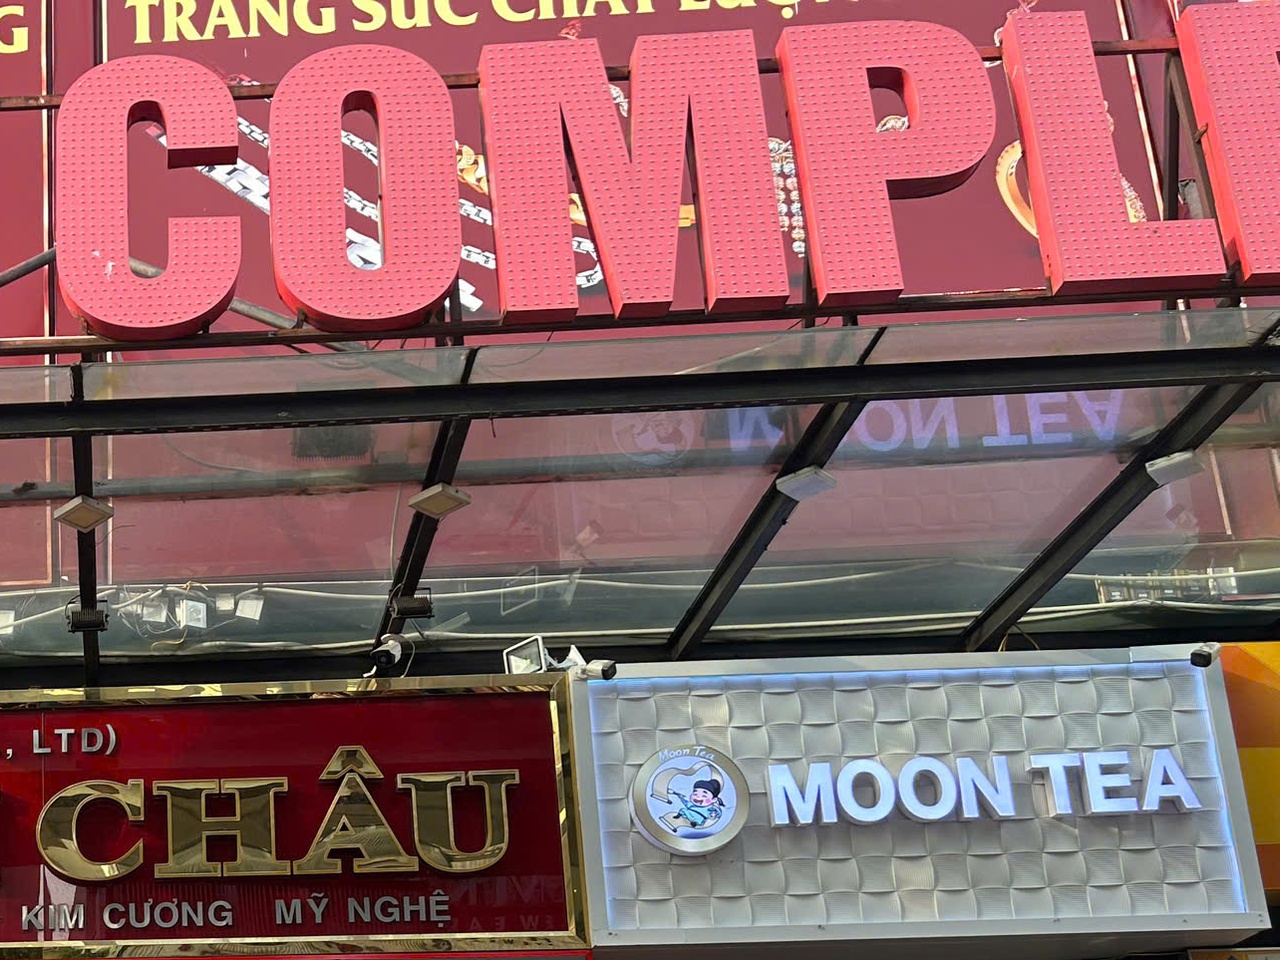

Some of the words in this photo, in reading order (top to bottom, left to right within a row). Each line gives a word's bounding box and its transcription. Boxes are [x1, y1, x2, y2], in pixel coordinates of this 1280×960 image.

[124, 0, 337, 44] TRANG
[32, 723, 117, 756] LTD)
[658, 748, 690, 762] Moon
[693, 746, 715, 760] Tea
[768, 754, 1017, 828] MOON
[1026, 747, 1203, 818] TEA
[36, 744, 520, 881] CHÂU
[22, 903, 85, 932] KIM
[104, 898, 233, 930] CƯƠNG
[276, 892, 330, 924] MỸ
[348, 888, 452, 927] NGHỆ
